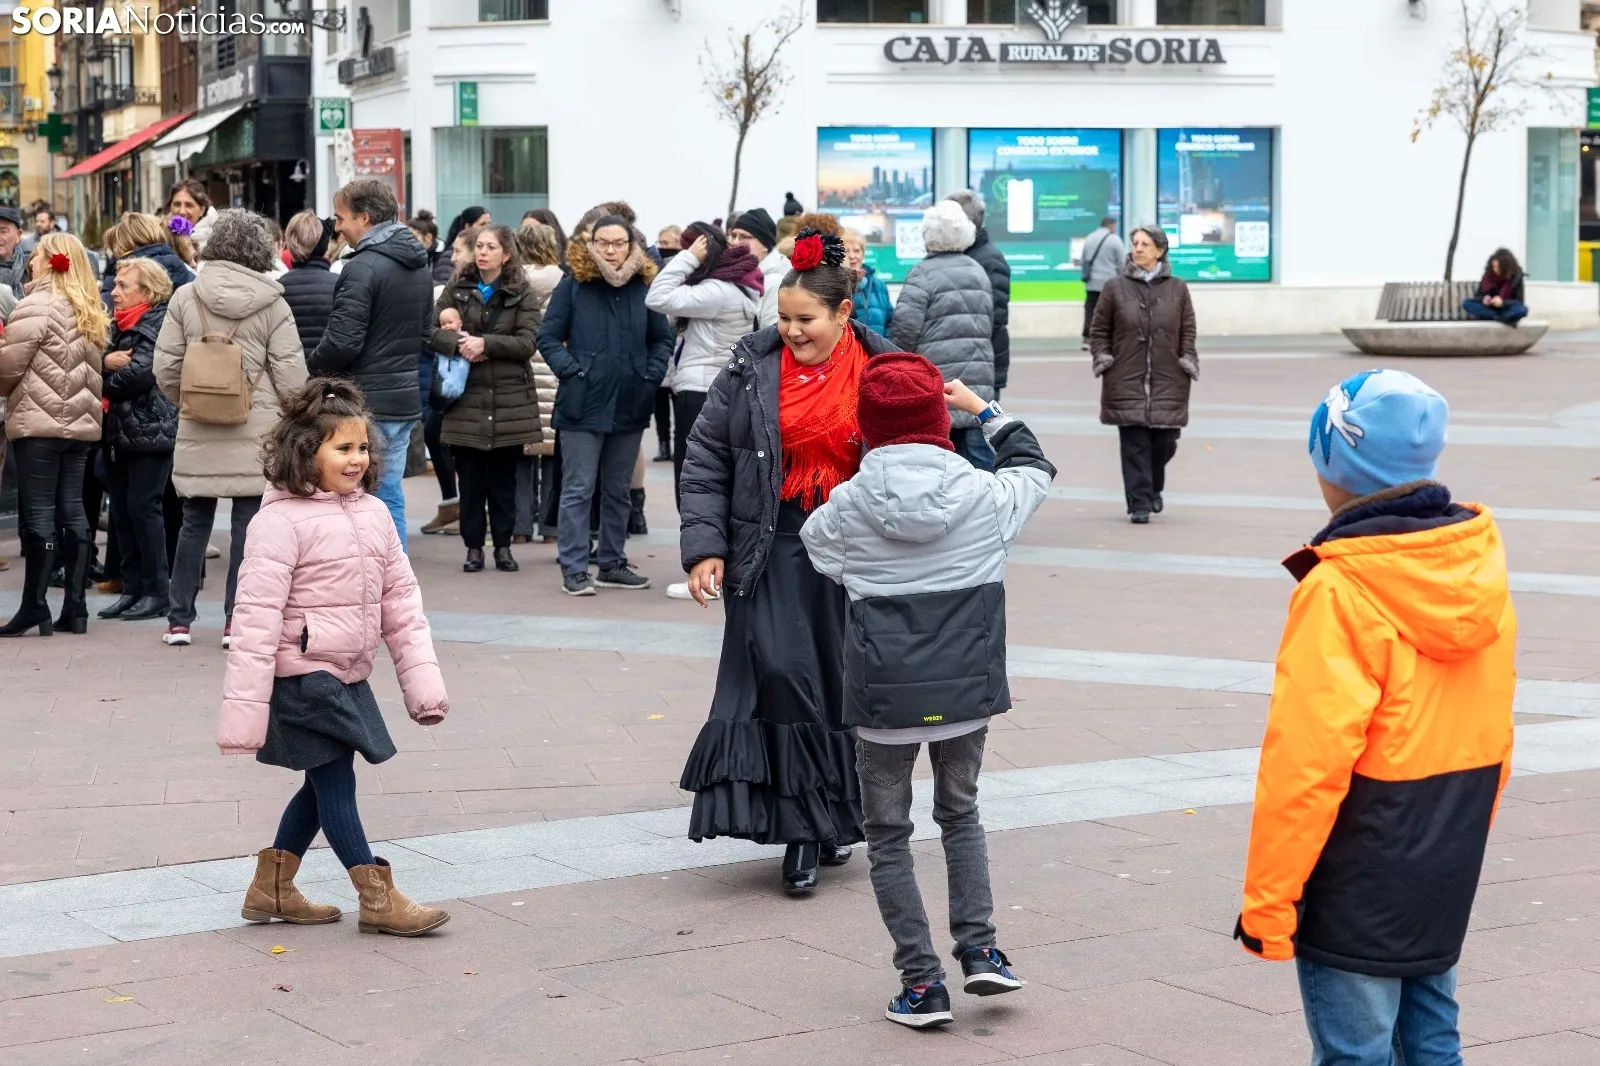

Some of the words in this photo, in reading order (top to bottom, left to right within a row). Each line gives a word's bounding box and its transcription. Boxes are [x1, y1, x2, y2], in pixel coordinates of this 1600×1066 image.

[883, 37, 996, 65] CAJA
[1007, 45, 1068, 61] RURAL
[1073, 45, 1100, 61] DE
[1108, 38, 1227, 64] SORIA
